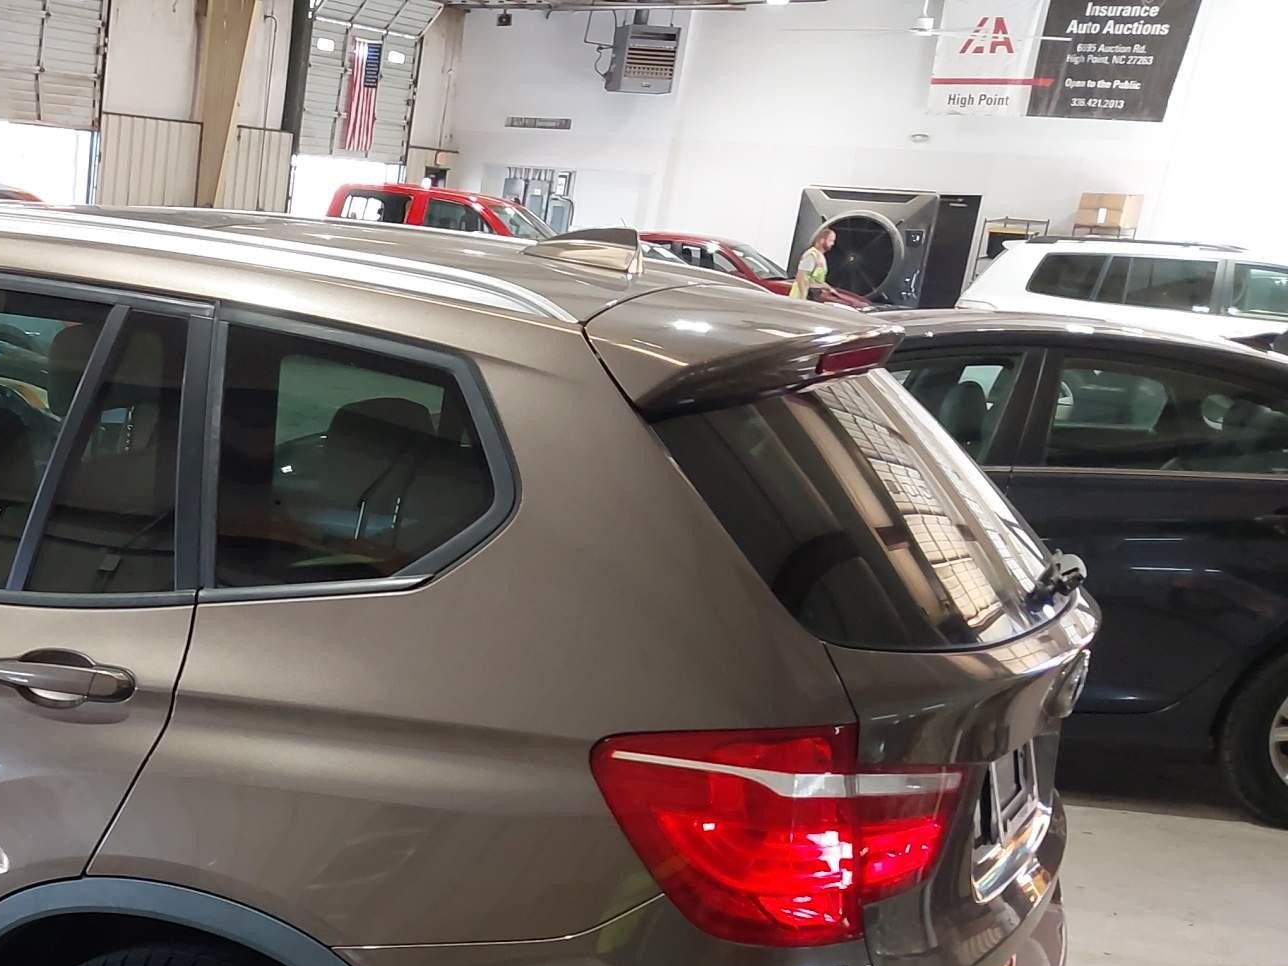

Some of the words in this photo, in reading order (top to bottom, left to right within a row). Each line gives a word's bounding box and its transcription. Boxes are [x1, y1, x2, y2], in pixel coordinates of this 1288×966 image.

[1085, 2, 1160, 17] Insurance
[1066, 19, 1101, 34] Auto
[1102, 19, 1170, 35] Auctions
[1066, 54, 1085, 65] High
[1111, 55, 1126, 65] NC
[1064, 78, 1086, 89] Open
[1087, 79, 1096, 88] to
[1096, 79, 1112, 89] the
[1112, 79, 1141, 90] Public
[947, 93, 975, 108] High
[978, 93, 1010, 106] Point
